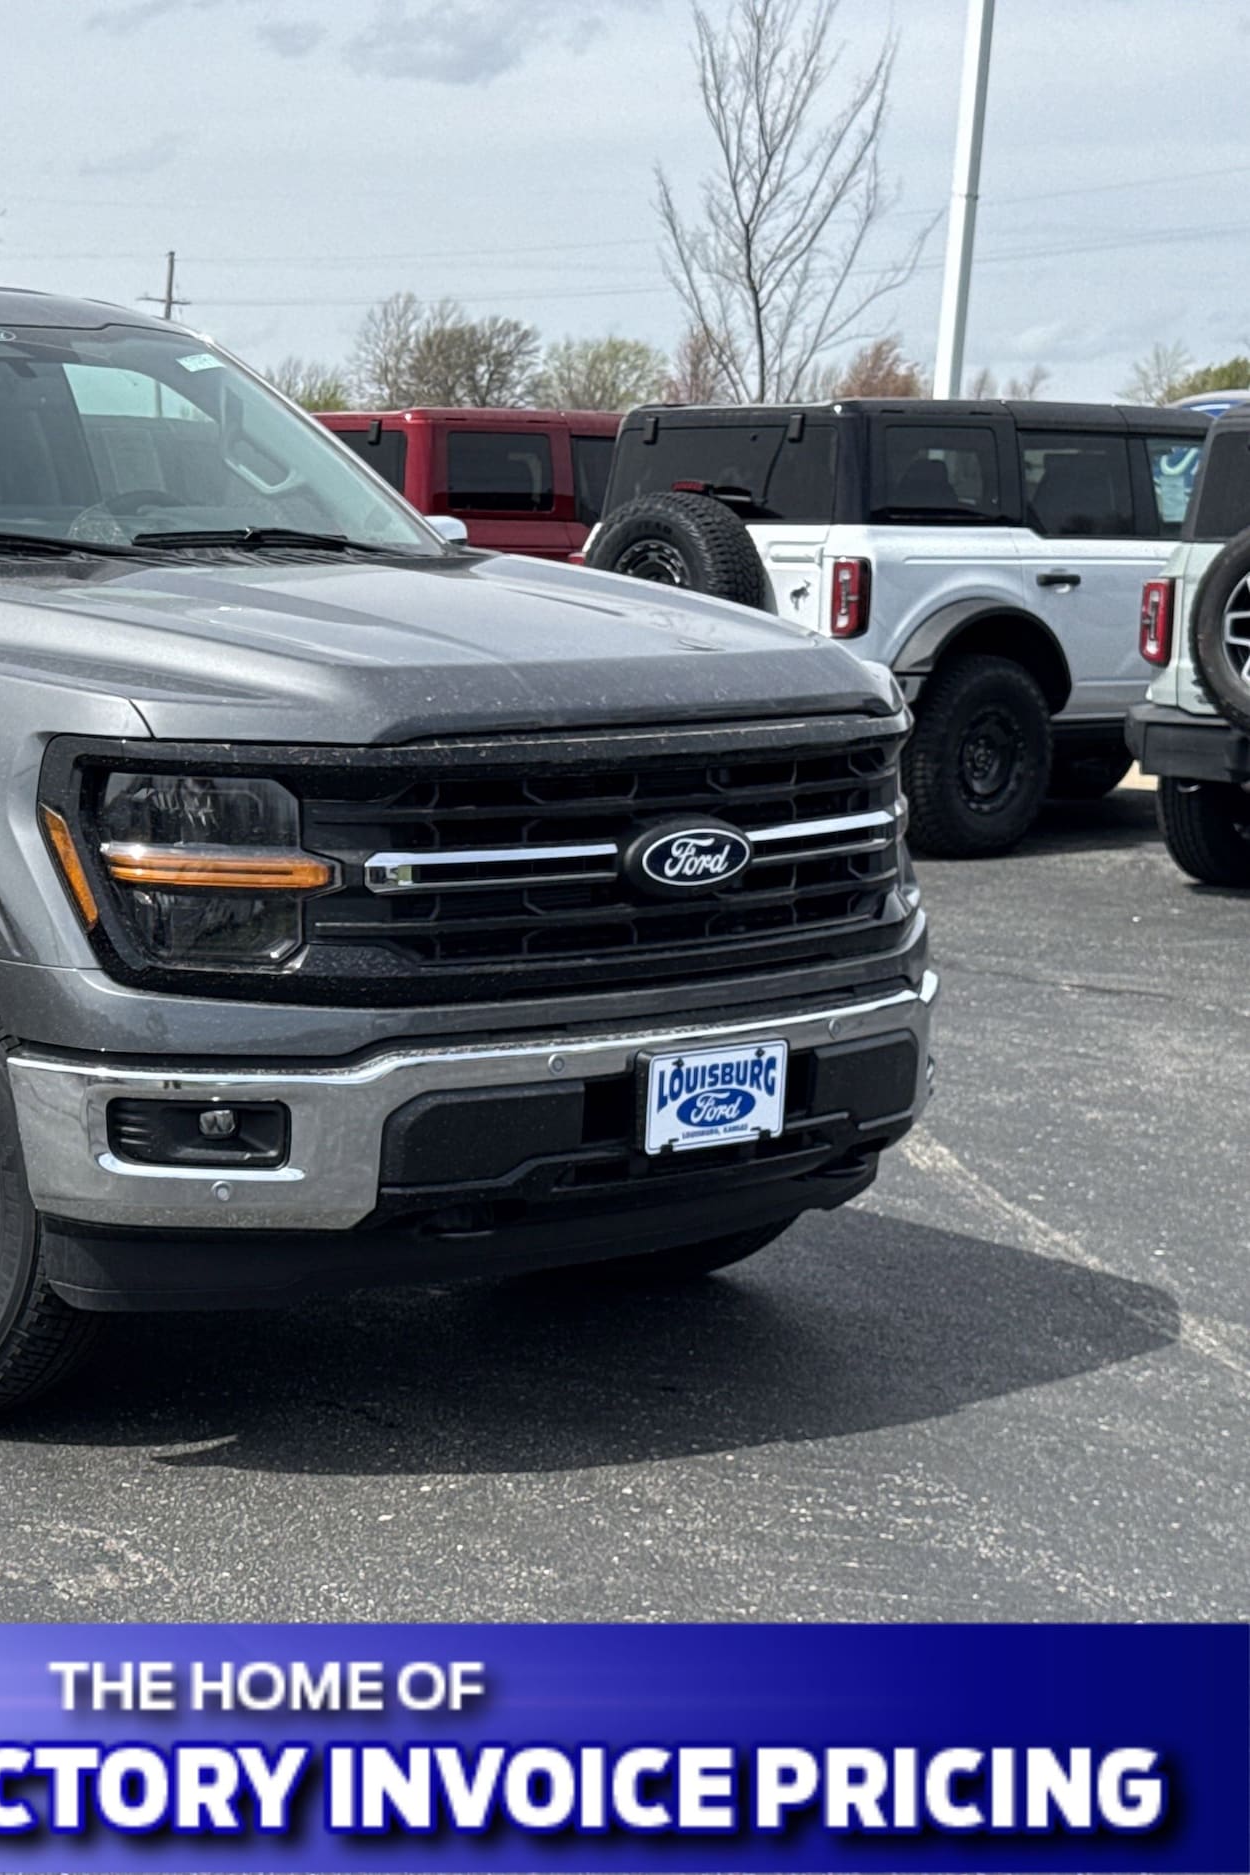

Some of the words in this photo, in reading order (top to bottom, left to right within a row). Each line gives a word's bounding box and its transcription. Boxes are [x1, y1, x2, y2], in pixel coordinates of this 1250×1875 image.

[664, 838, 731, 877] Ford
[657, 1056, 777, 1114] LOUISBURG
[690, 1091, 743, 1124] Ford
